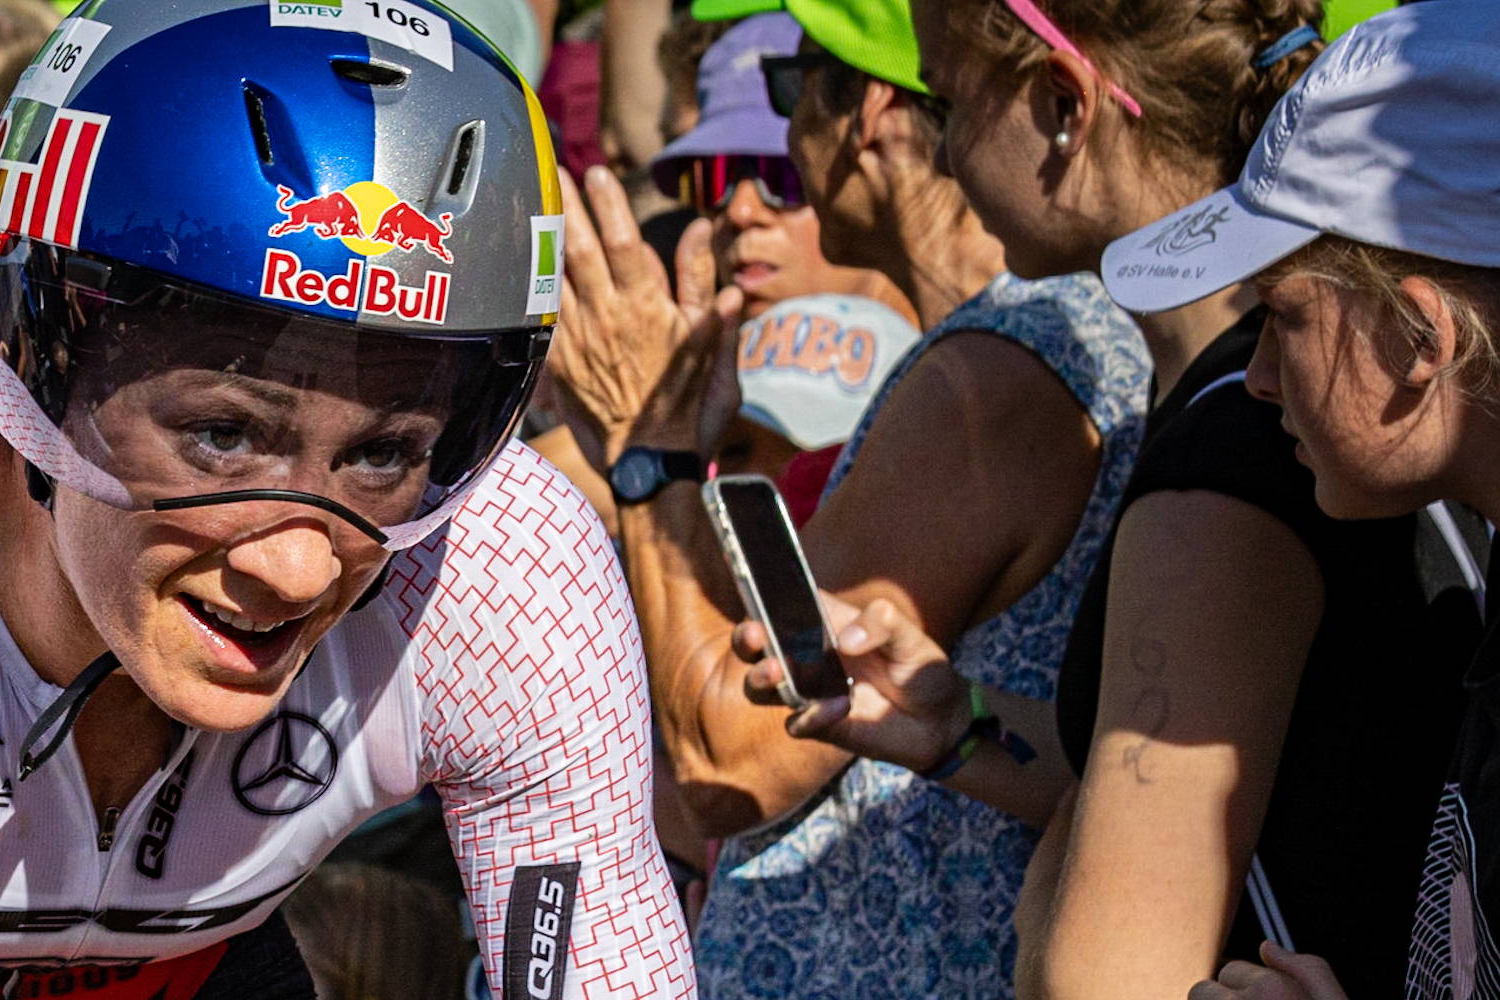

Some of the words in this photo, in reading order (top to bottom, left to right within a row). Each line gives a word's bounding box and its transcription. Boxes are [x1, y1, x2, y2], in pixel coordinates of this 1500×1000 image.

[277, 4, 343, 19] DATEV
[364, 1, 431, 37] 106
[47, 42, 82, 74] 106
[262, 249, 362, 309] Red
[364, 266, 449, 322] Bull
[527, 876, 565, 1000] Q36.5
